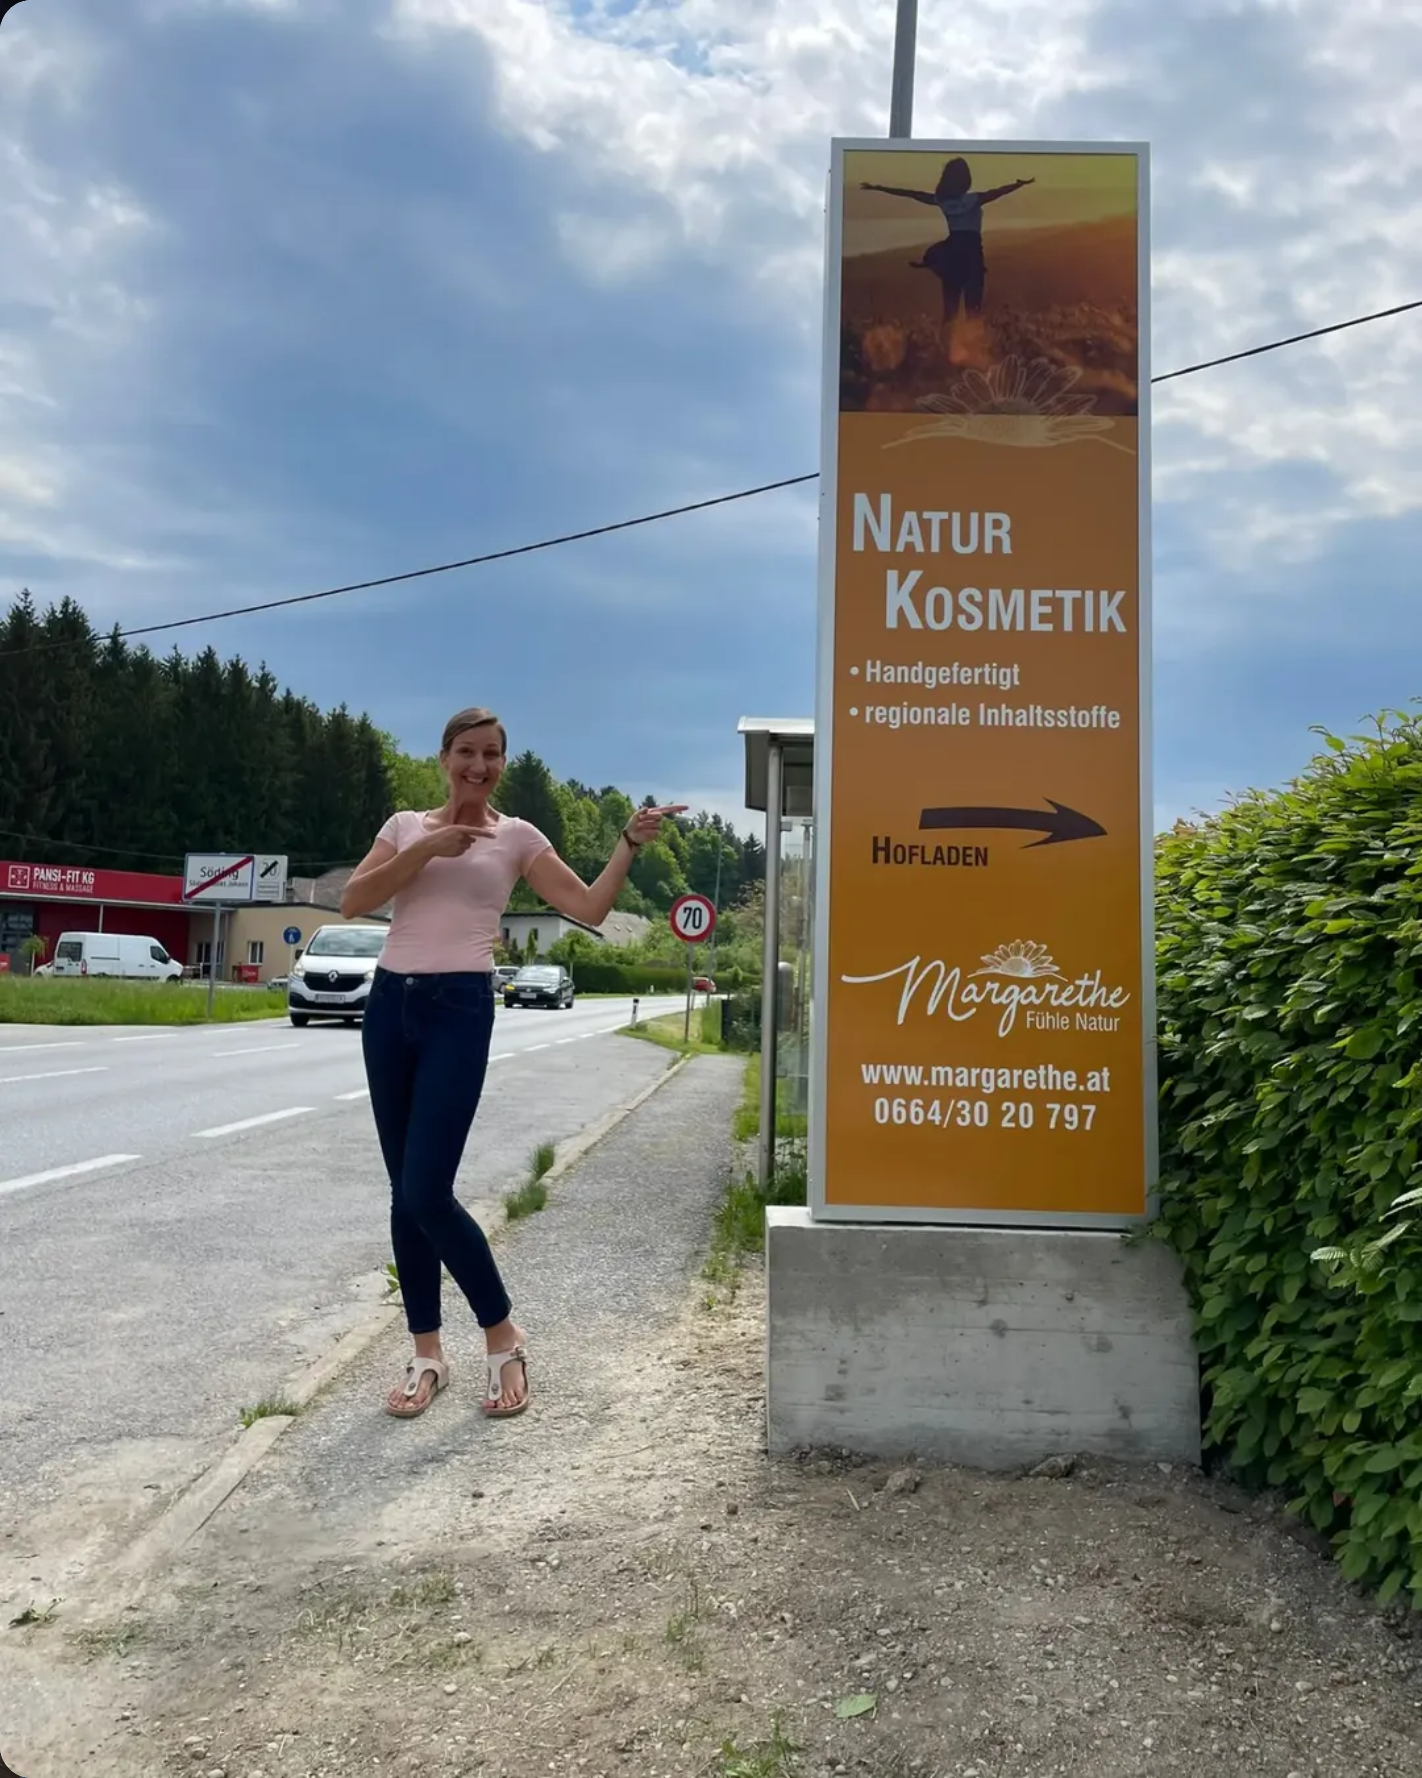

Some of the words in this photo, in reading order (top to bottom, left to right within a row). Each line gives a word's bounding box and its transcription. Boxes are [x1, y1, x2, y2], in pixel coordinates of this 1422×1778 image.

[852, 492, 1012, 555] NATUR
[885, 569, 1127, 632] KOSMETIK
[865, 660, 1020, 690] Handgefertigt
[864, 702, 970, 729] regionale
[979, 703, 1120, 729] Inhaltsstoffe
[872, 836, 989, 867] HOFLADEN
[33, 867, 80, 884] PANSI-FIT
[82, 871, 95, 885] KG
[683, 907, 703, 929] 70
[841, 955, 1130, 1037] Margarethe
[1026, 1011, 1070, 1031] Fühle
[1076, 1012, 1120, 1032] Natur
[861, 1063, 1111, 1094] www.margarethe.at
[874, 1098, 989, 1129] 0664/30
[1001, 1101, 1034, 1129] 20
[1046, 1103, 1097, 1131] 797
